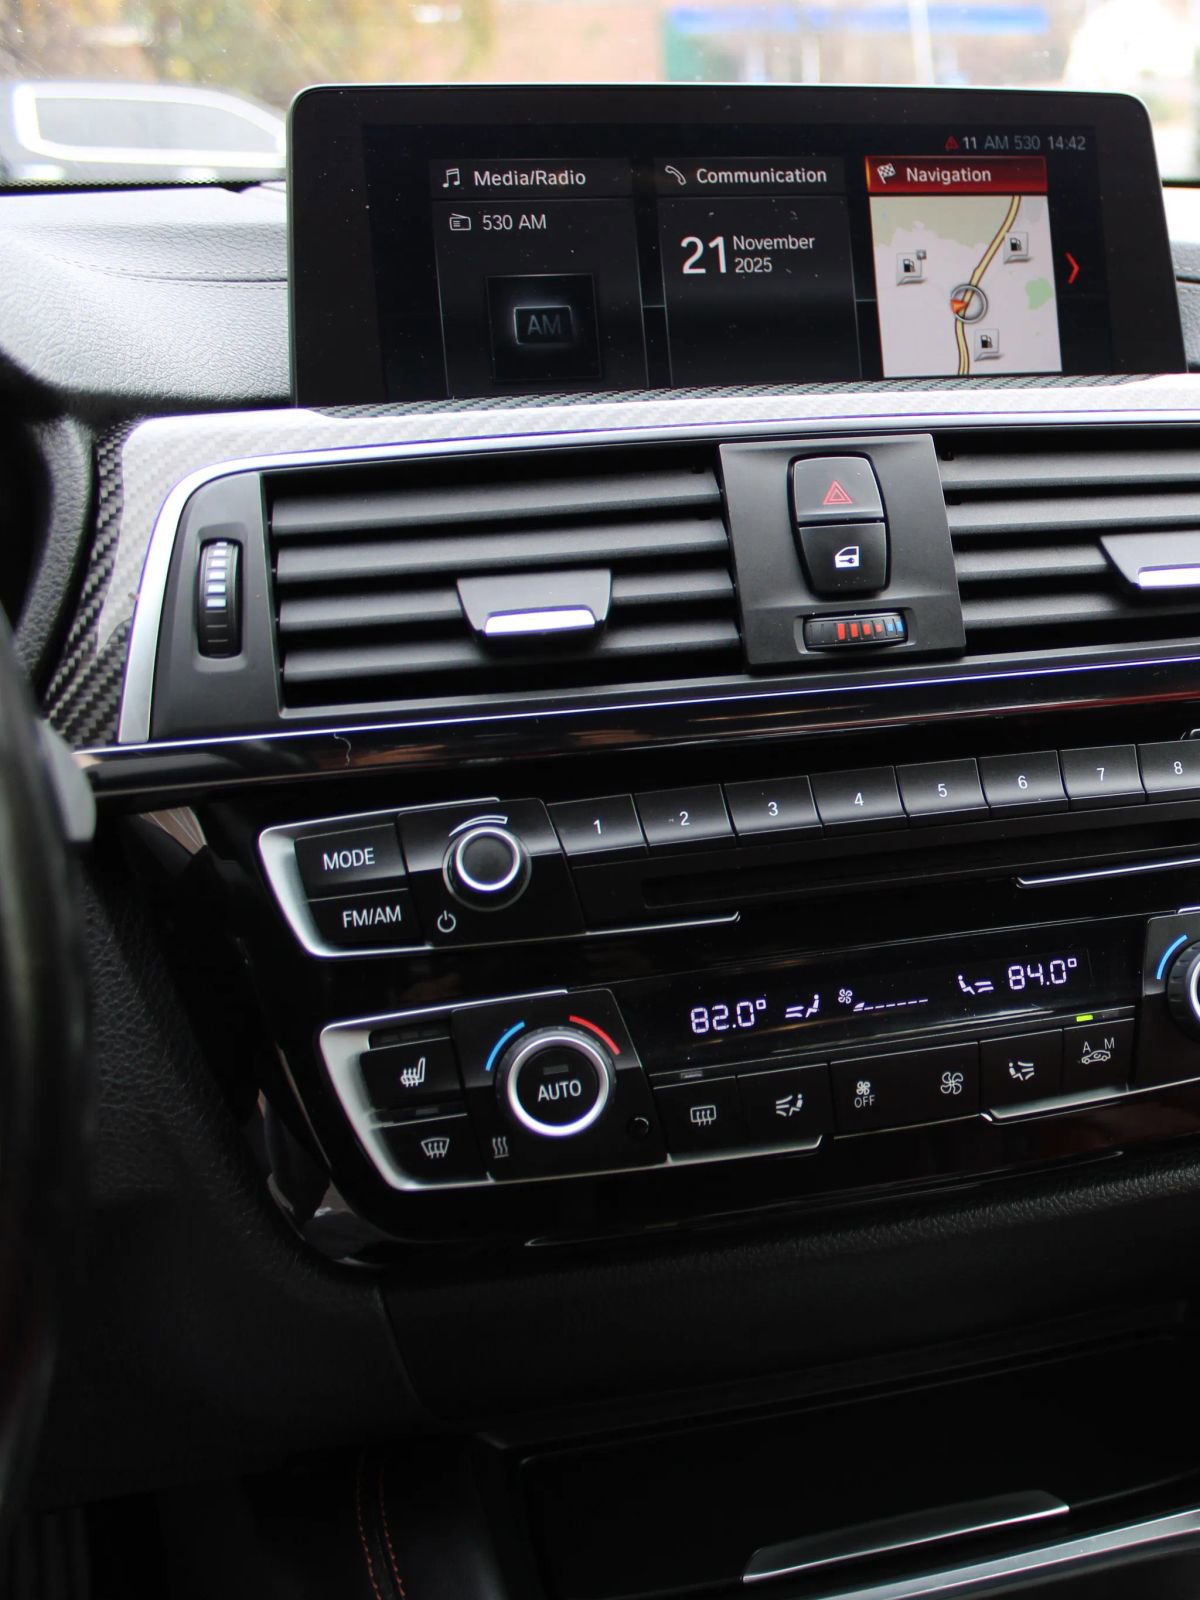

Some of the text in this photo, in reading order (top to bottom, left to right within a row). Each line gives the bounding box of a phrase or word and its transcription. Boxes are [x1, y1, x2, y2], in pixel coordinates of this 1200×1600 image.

[962, 135, 1086, 150] 11 AM 530 14:42
[473, 168, 587, 188] Media/Radio
[696, 167, 828, 185] Communication
[905, 166, 992, 185] Navigation
[482, 213, 548, 231] 530 AM
[732, 234, 816, 251] November
[681, 235, 727, 274] 21
[734, 256, 773, 274] 2025
[526, 314, 562, 337] AM
[1096, 768, 1106, 782] 7
[1173, 761, 1183, 775] 8
[1018, 775, 1028, 790] 6
[937, 784, 947, 798] 5
[854, 792, 864, 807] 4
[767, 802, 778, 817] 3
[592, 819, 602, 835] 1
[680, 811, 690, 827] 2
[322, 847, 375, 871] MODE
[342, 905, 402, 929] FM/AM
[1082, 1037, 1116, 1053] A M
[537, 1080, 582, 1103] AUTO
[854, 1094, 875, 1109] OFF
